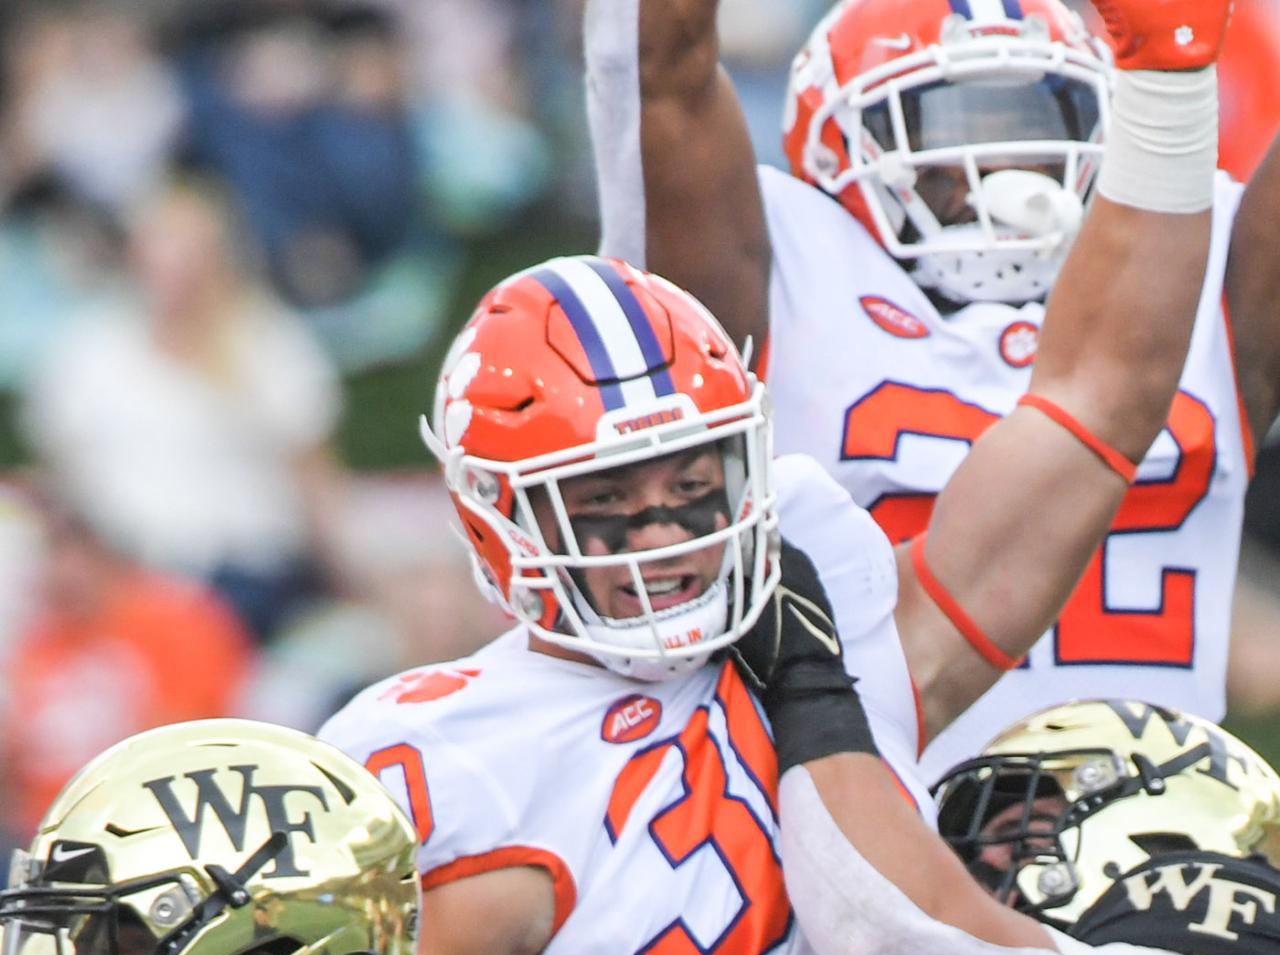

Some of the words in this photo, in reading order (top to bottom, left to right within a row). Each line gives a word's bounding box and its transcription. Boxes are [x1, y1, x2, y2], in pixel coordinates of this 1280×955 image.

[609, 698, 655, 739] ACC
[142, 764, 331, 879] WF
[1122, 861, 1275, 942] WF
